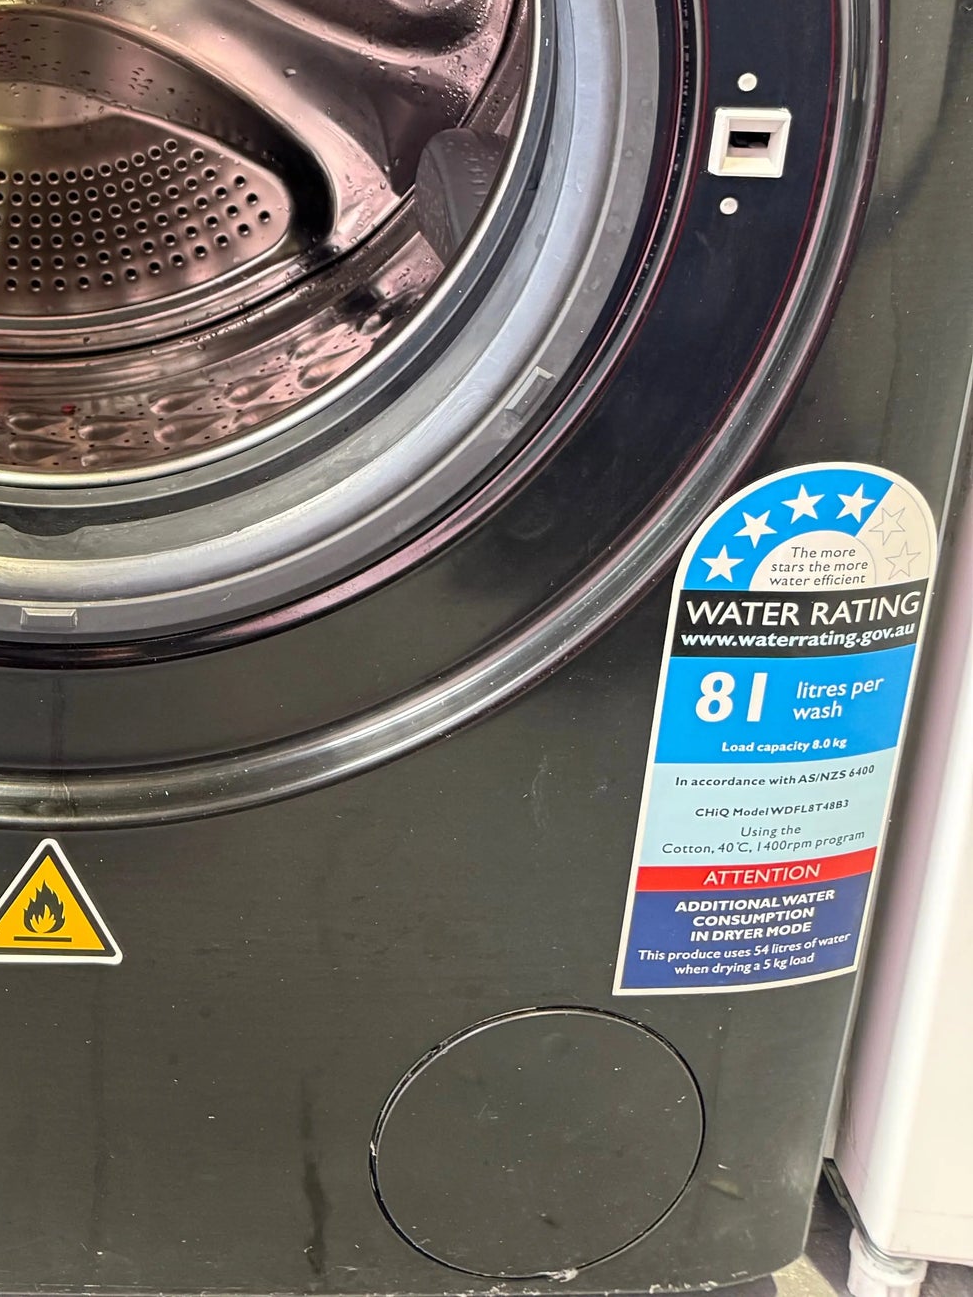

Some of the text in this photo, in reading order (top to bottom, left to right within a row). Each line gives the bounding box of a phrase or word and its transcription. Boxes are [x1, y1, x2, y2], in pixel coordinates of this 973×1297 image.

[791, 546, 856, 558] The more
[771, 560, 868, 573] stars the more
[769, 574, 866, 586] water efficient
[686, 591, 921, 626] WATER RATING
[681, 622, 915, 648] www.waterrating.gov.au
[695, 671, 884, 722] 81 litres per
[792, 700, 843, 720] wash
[721, 737, 847, 755] Load capacity 8.0 kg
[675, 765, 875, 787] In accordance with AS/NZS 6400
[695, 799, 849, 818] CHiQ Model WDFL8T48B3
[740, 824, 801, 840] Using the
[661, 843, 715, 855] Cotton,
[757, 839, 813, 854] 1400rpm
[815, 831, 865, 850] program
[703, 863, 821, 886] ATTENTION
[674, 889, 835, 913] ADDITIONAL WATER
[692, 907, 815, 927] CONSUMPTION
[690, 921, 812, 942] IN DRYER MODE
[638, 933, 851, 963] This produce uses 54 litres of water
[674, 953, 815, 976] when drying a 5 kg load
